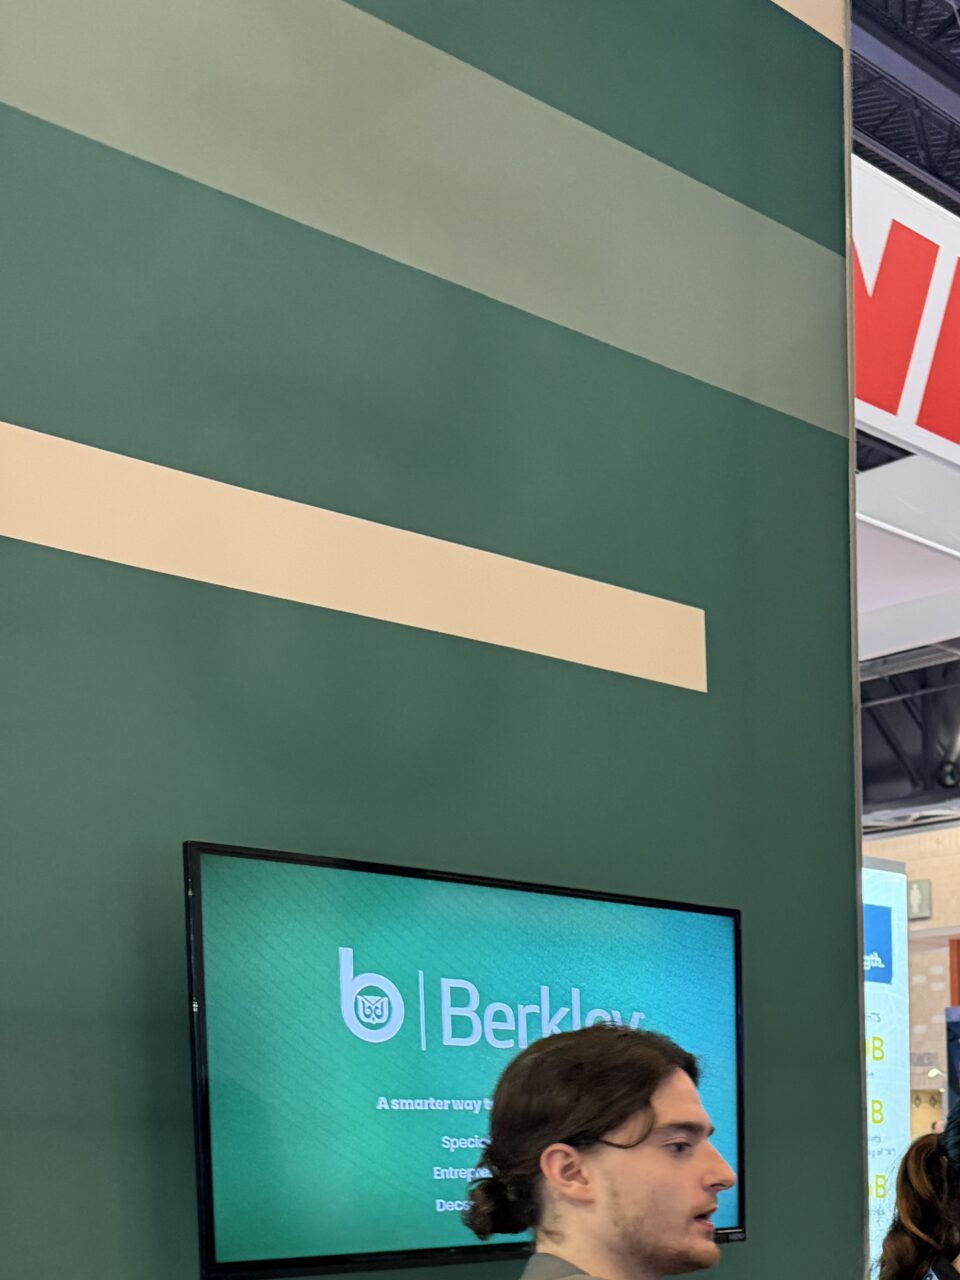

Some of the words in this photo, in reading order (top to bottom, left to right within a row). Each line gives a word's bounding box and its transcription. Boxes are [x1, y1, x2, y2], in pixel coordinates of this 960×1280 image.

[376, 1096, 389, 1110] A
[390, 1097, 450, 1110] smarter
[451, 1099, 482, 1114] way
